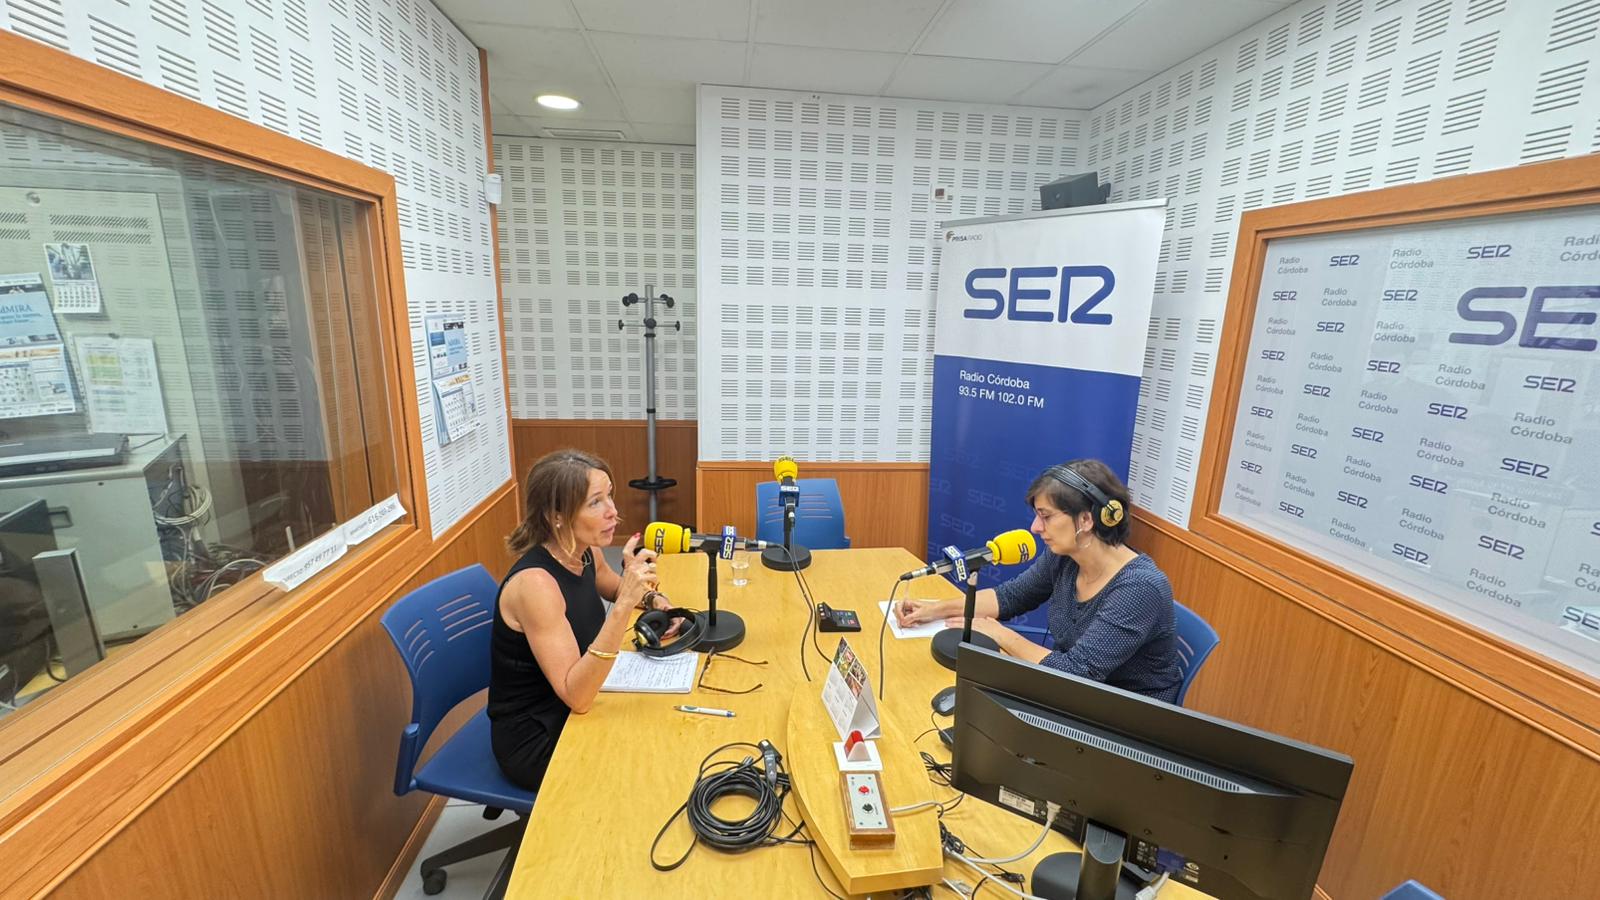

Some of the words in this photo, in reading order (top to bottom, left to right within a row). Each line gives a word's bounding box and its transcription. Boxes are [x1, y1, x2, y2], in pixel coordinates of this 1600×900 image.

[1392, 247, 1422, 258] Radio
[1465, 244, 1513, 260] SER
[1279, 257, 1300, 265] Radio
[1329, 254, 1360, 267] SER
[1390, 258, 1434, 270] Córdoba
[1277, 266, 1309, 275] Córdoba
[963, 265, 1116, 325] SER
[1272, 290, 1298, 301] SER
[1324, 288, 1348, 296] Radio
[1382, 289, 1419, 302] SER
[1321, 298, 1357, 307] Córdoba
[1268, 317, 1289, 325] Radio
[1316, 321, 1345, 333] SER
[1376, 321, 1404, 331] Radio
[1266, 326, 1296, 336] Córdoba
[1374, 332, 1416, 344] Córdoba
[1261, 349, 1285, 361] SER
[1310, 352, 1334, 361] Radio
[1308, 362, 1343, 373] Córdoba
[1366, 359, 1401, 374] SER
[1438, 363, 1472, 375] Radio
[960, 370, 985, 383] Radio
[987, 373, 1030, 389] Córdoba
[1257, 375, 1276, 384] Radio
[1434, 375, 1486, 391] Córdoba
[1523, 375, 1577, 393] SER
[1255, 384, 1284, 395] Córdoba
[1303, 384, 1331, 398] SER
[1360, 390, 1388, 401] Radio
[959, 386, 977, 398] 93.5
[979, 389, 995, 400] FM
[997, 391, 1025, 405] 102.0
[1027, 395, 1044, 408] FM
[1250, 406, 1274, 419] SER
[1358, 401, 1399, 415] Córdoba
[1427, 402, 1469, 420] SER
[1297, 413, 1320, 424] Radio
[1513, 412, 1556, 427] Radio
[1247, 430, 1265, 440] Radio
[1295, 423, 1329, 437] Córdoba
[1351, 426, 1385, 443] SER
[1510, 425, 1573, 445] Córdoba
[1290, 444, 1318, 459] SER
[1419, 438, 1452, 452] Radio
[1346, 455, 1372, 468] Radio
[1416, 449, 1465, 468] Córdoba
[1240, 460, 1263, 474] SER
[1500, 457, 1551, 479] SER
[1285, 472, 1307, 484] Radio
[1343, 466, 1382, 483] Córdoba
[1236, 483, 1254, 495] Radio
[1283, 481, 1315, 497] Córdoba
[1409, 474, 1449, 495] SER
[1336, 490, 1369, 509] SER
[1490, 492, 1531, 510] Radio
[1279, 501, 1305, 518] SER
[1401, 508, 1432, 524] Radio
[1487, 505, 1547, 529] Córdoba
[1331, 518, 1357, 533] Radio
[1399, 519, 1445, 541] Córdoba
[655, 527, 665, 557] SER
[1329, 528, 1366, 548] Córdoba
[723, 536, 734, 559] SER
[1391, 542, 1430, 565] SER
[1478, 535, 1526, 561] SER
[955, 558, 967, 582] SER
[1469, 568, 1507, 588] Radio
[1466, 580, 1522, 608] Córdoba
